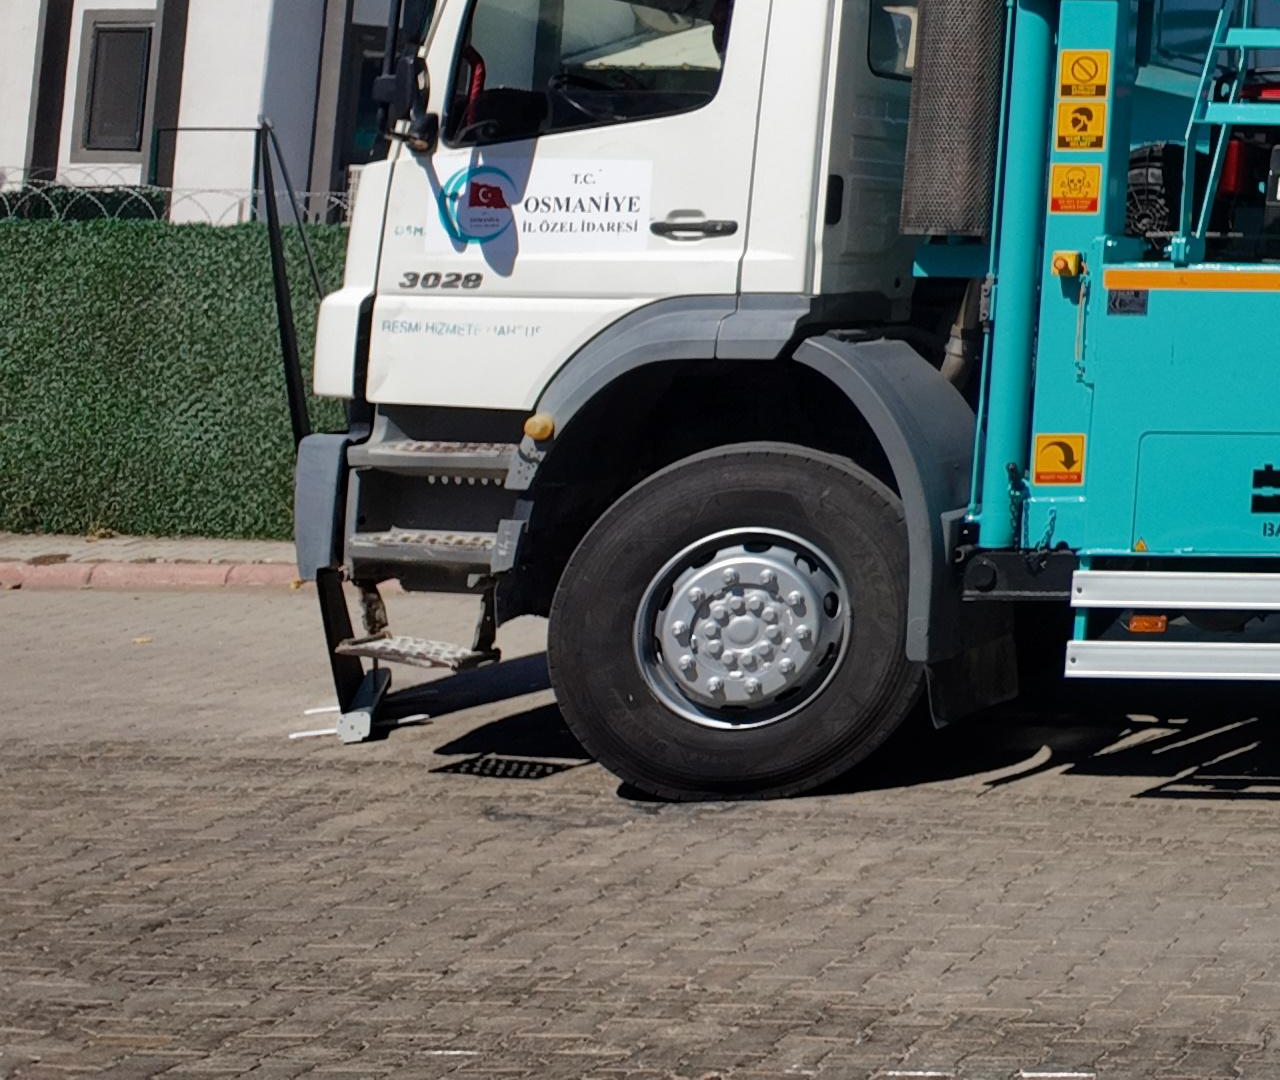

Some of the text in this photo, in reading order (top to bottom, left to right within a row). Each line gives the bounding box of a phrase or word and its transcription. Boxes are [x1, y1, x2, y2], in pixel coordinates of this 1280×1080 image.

[572, 173, 596, 184] T.C.
[524, 192, 640, 213] OSMANİYE
[522, 220, 638, 233] İL ÖZEL İDARESİ
[399, 272, 484, 289] 3028
